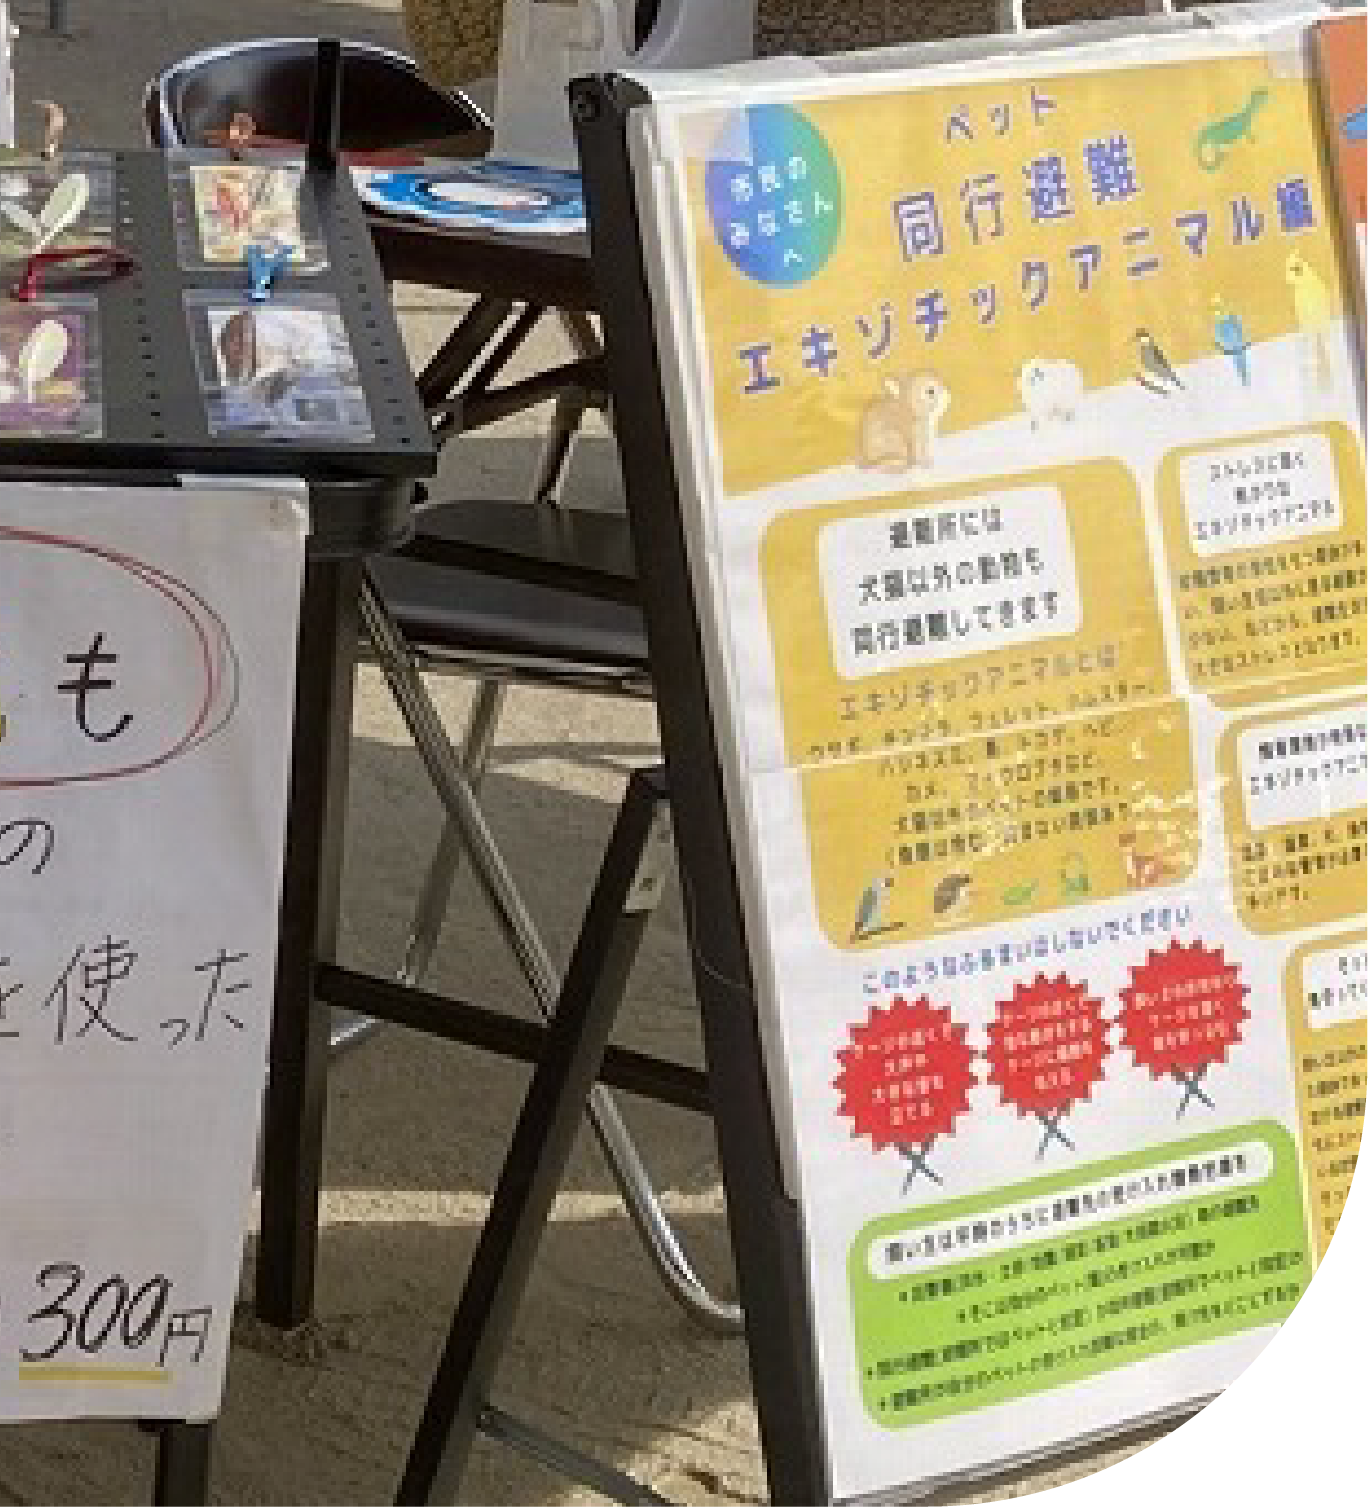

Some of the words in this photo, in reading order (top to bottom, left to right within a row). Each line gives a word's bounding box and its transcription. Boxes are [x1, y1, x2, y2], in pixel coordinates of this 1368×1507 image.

[944, 89, 1057, 142] ペット
[893, 134, 1139, 261] 同行避難
[737, 177, 1316, 396] エキゾチックアニマル編
[888, 507, 1002, 550] 避難所には
[857, 550, 1045, 607] 犬猫以外の動物も
[18, 1263, 214, 1369] 300円
